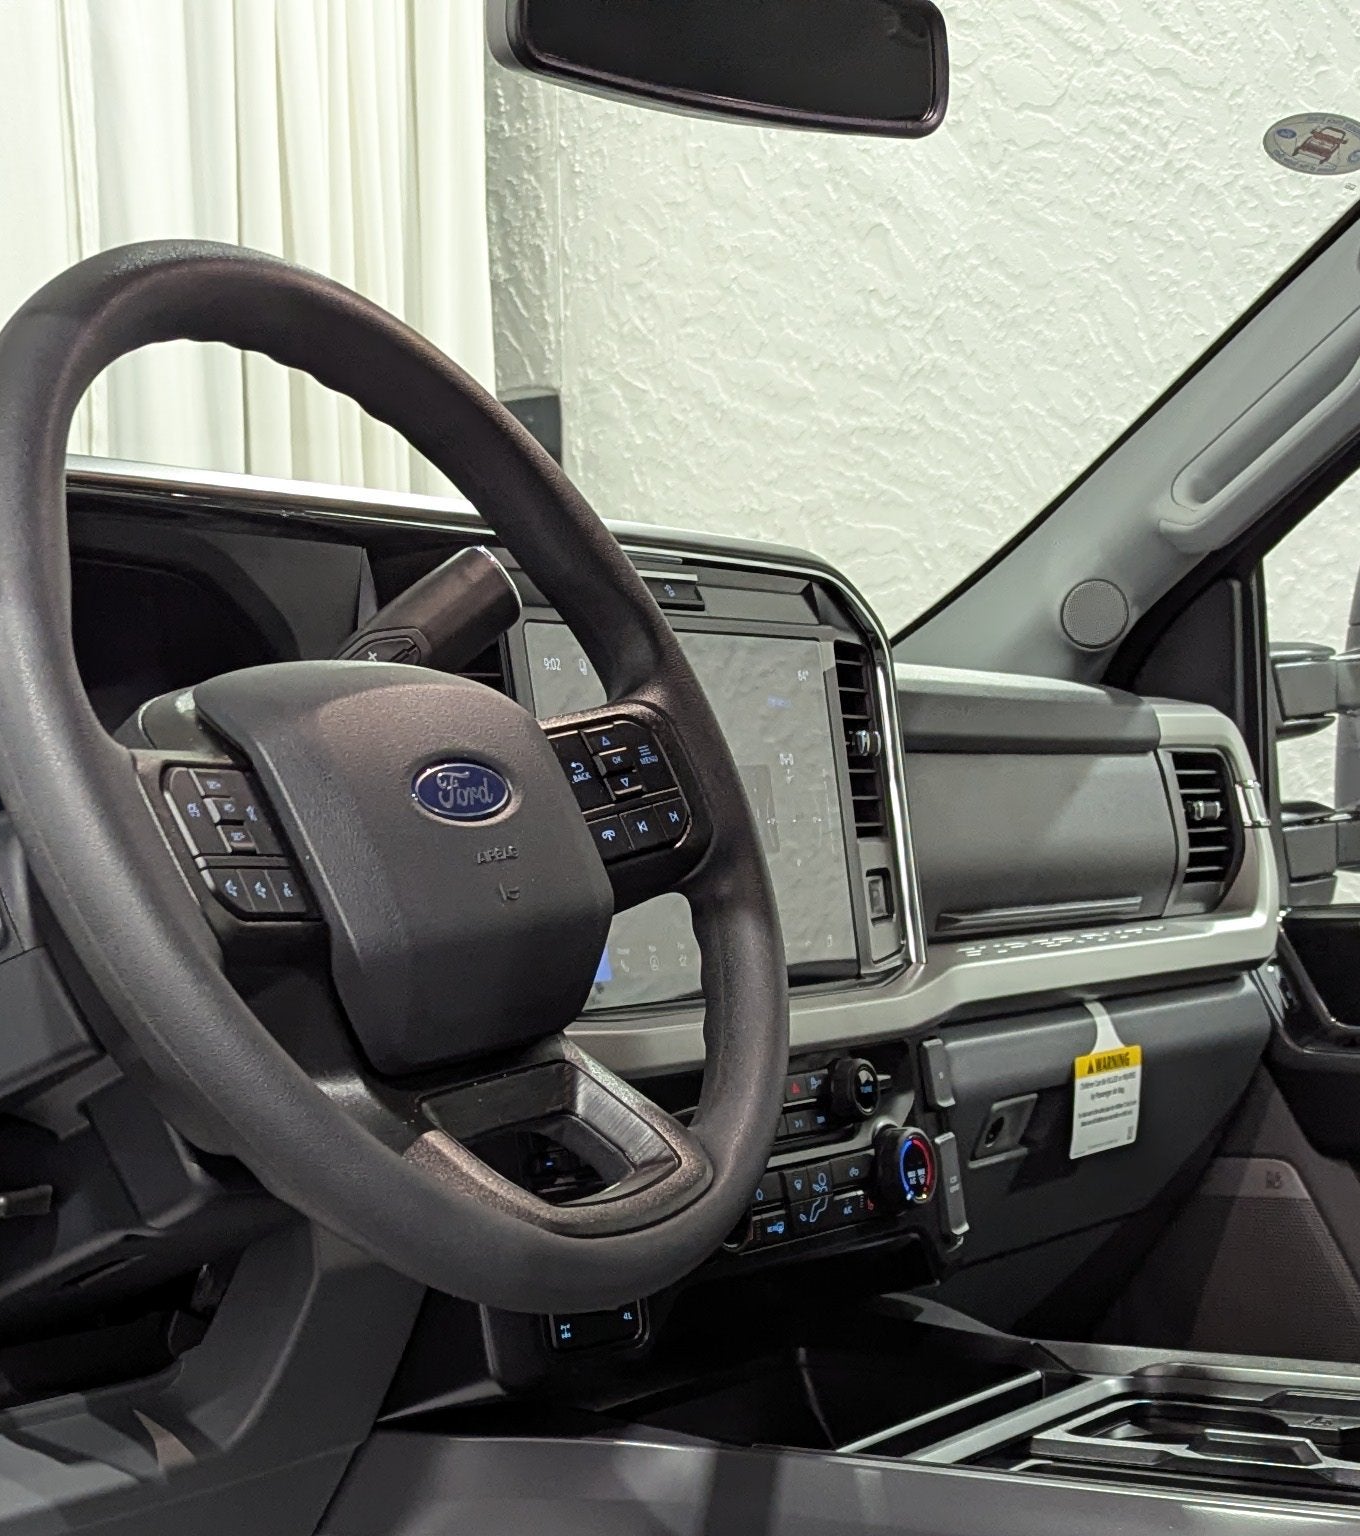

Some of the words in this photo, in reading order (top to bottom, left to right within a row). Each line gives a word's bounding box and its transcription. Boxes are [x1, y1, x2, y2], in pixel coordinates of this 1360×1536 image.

[543, 657, 561, 671] 9:02
[436, 766, 493, 809] Ford
[1095, 1051, 1130, 1072] WARNING
